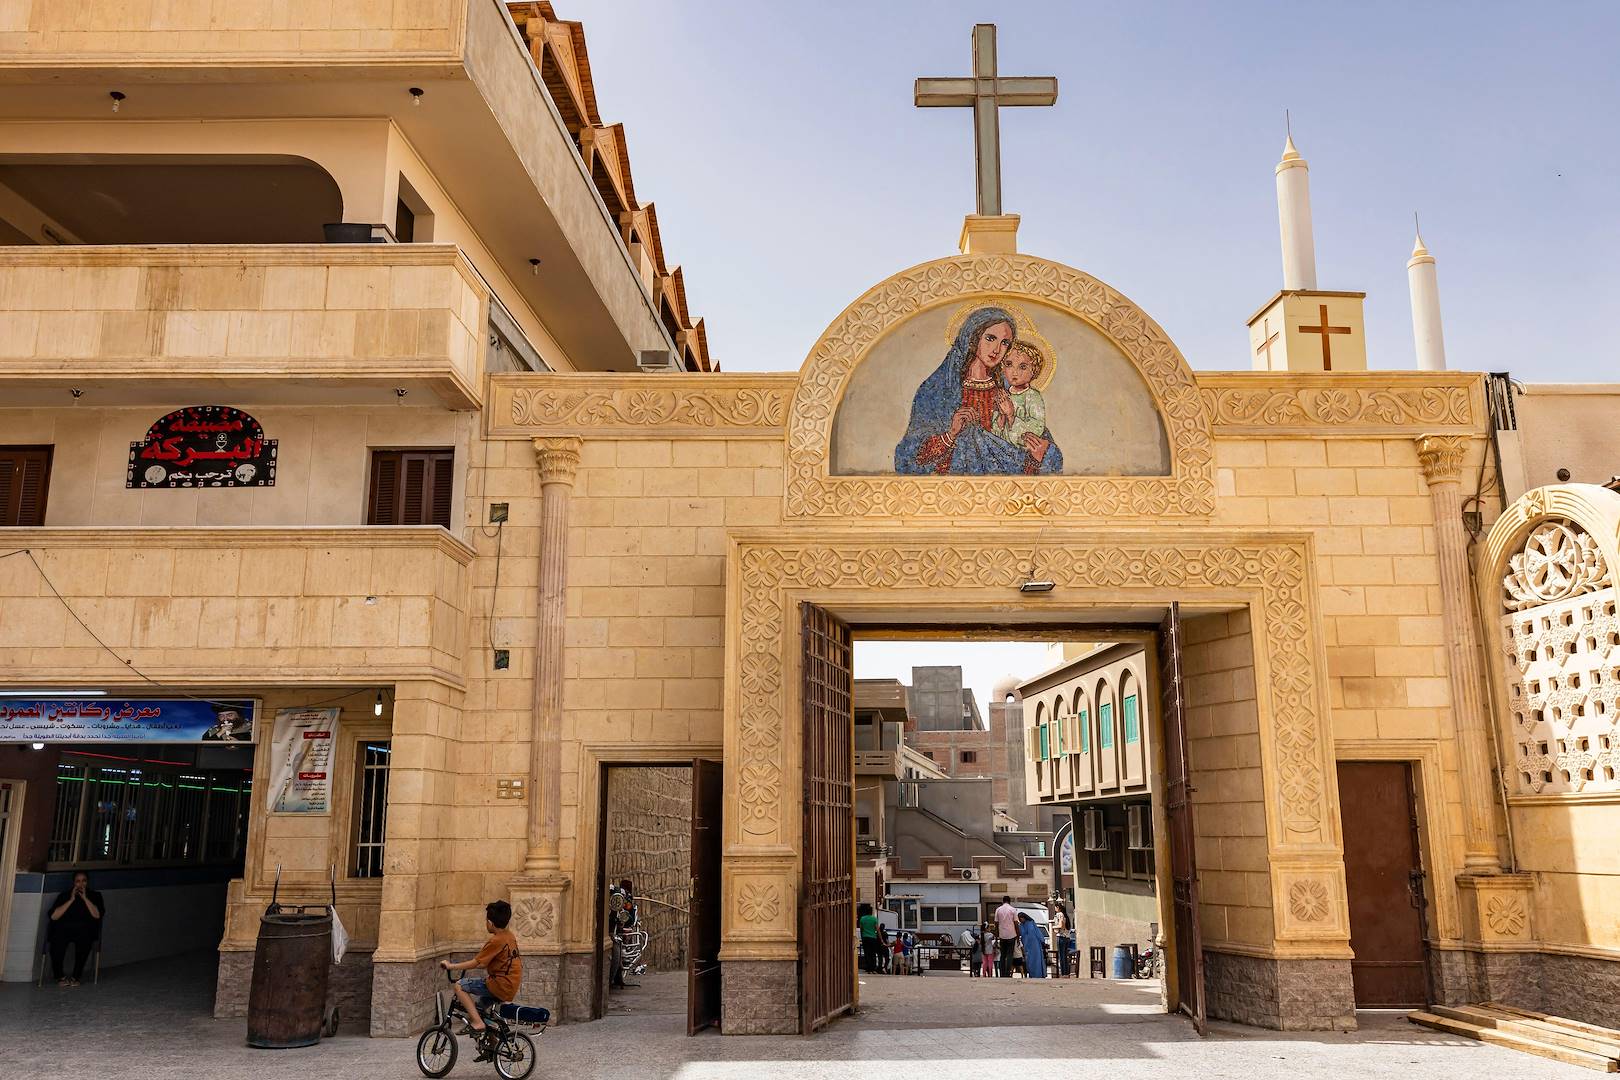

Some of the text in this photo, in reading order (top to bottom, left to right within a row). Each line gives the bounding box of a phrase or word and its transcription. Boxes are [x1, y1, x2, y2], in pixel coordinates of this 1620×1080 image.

[140, 434, 262, 467] البركة
[168, 469, 233, 482] ترحب بكم
[0, 702, 160, 722] معرض وكانتين المعمود
[8, 722, 25, 730] عسل
